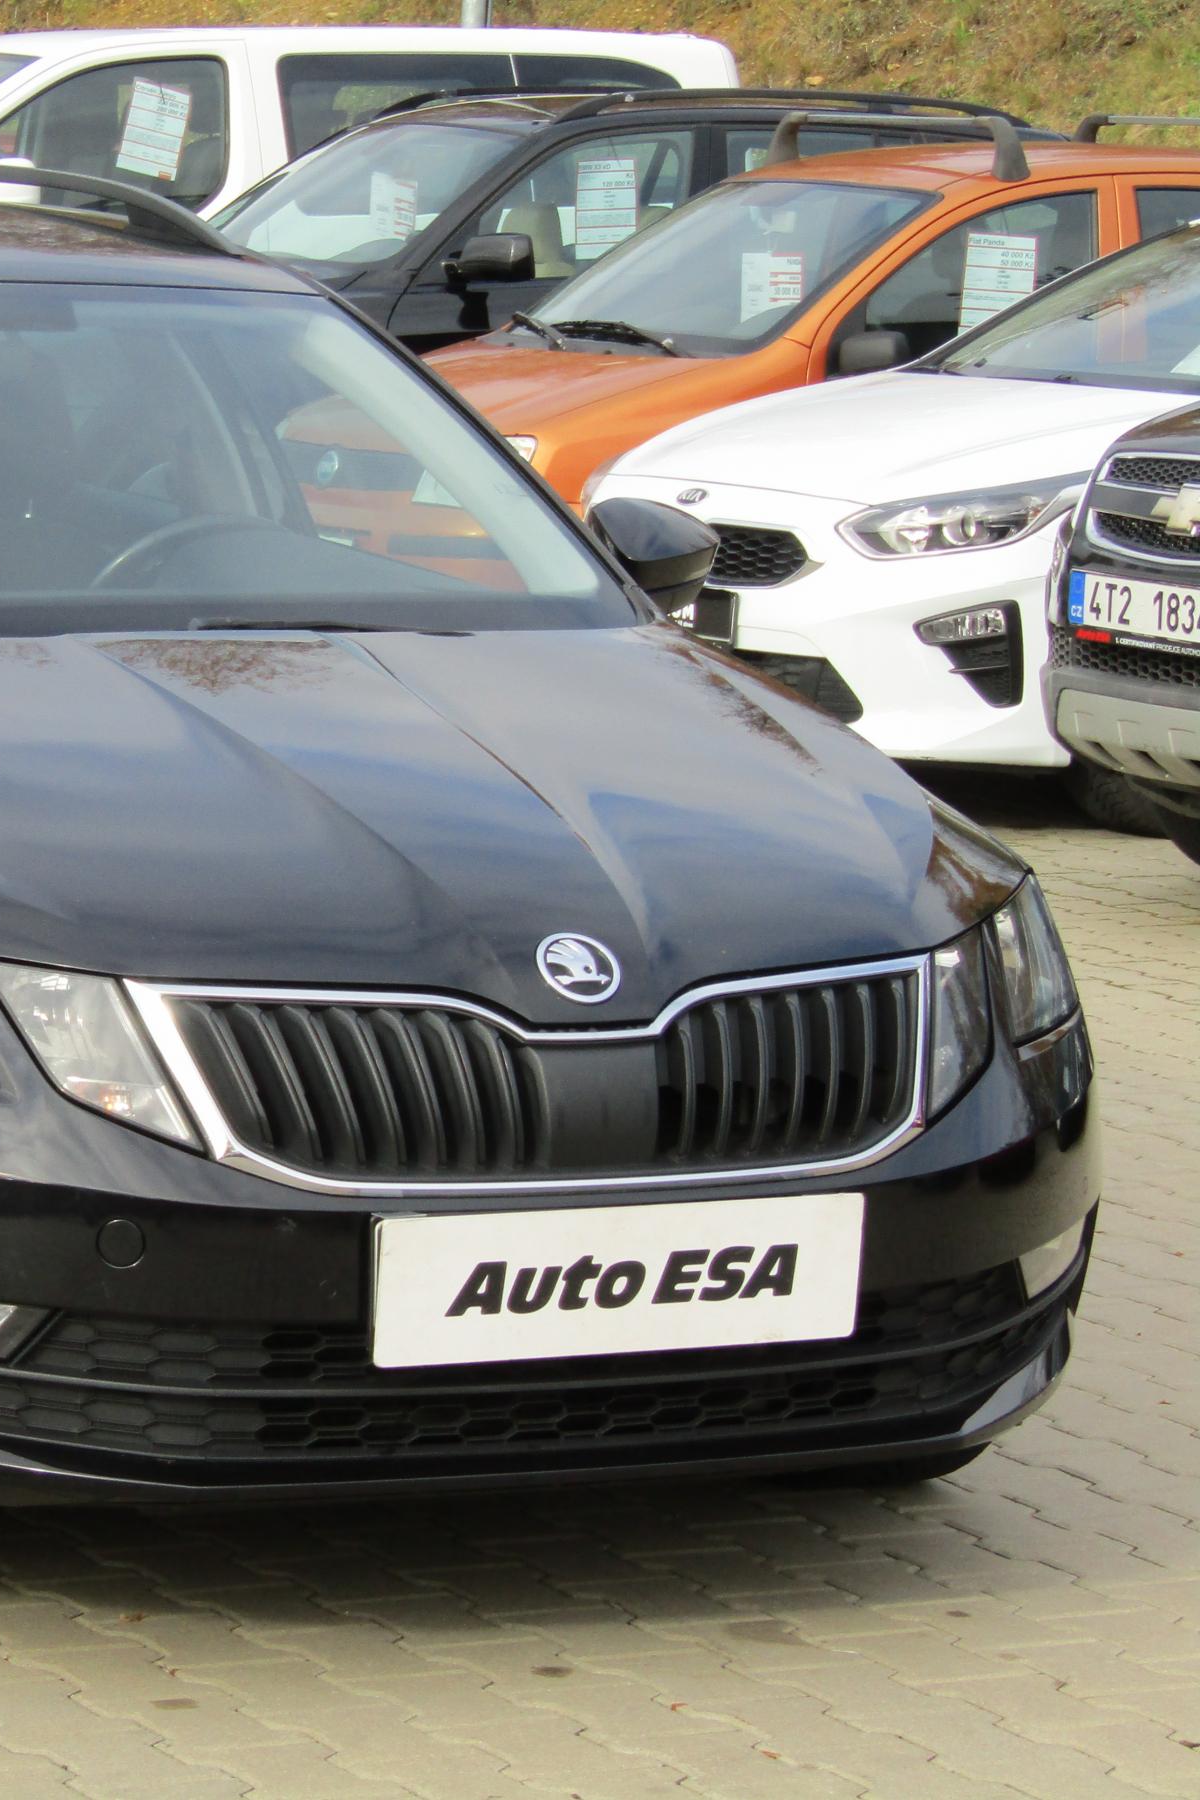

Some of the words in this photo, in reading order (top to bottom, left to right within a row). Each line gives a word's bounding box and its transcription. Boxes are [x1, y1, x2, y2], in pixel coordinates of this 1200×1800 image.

[983, 238, 1005, 246] Panda
[678, 489, 705, 502] KIA
[1071, 605, 1082, 617] CZ
[1089, 581, 1132, 625] 4T2
[1153, 590, 1200, 634] 183
[444, 1254, 646, 1317] Auto
[651, 1243, 798, 1304] ESA
